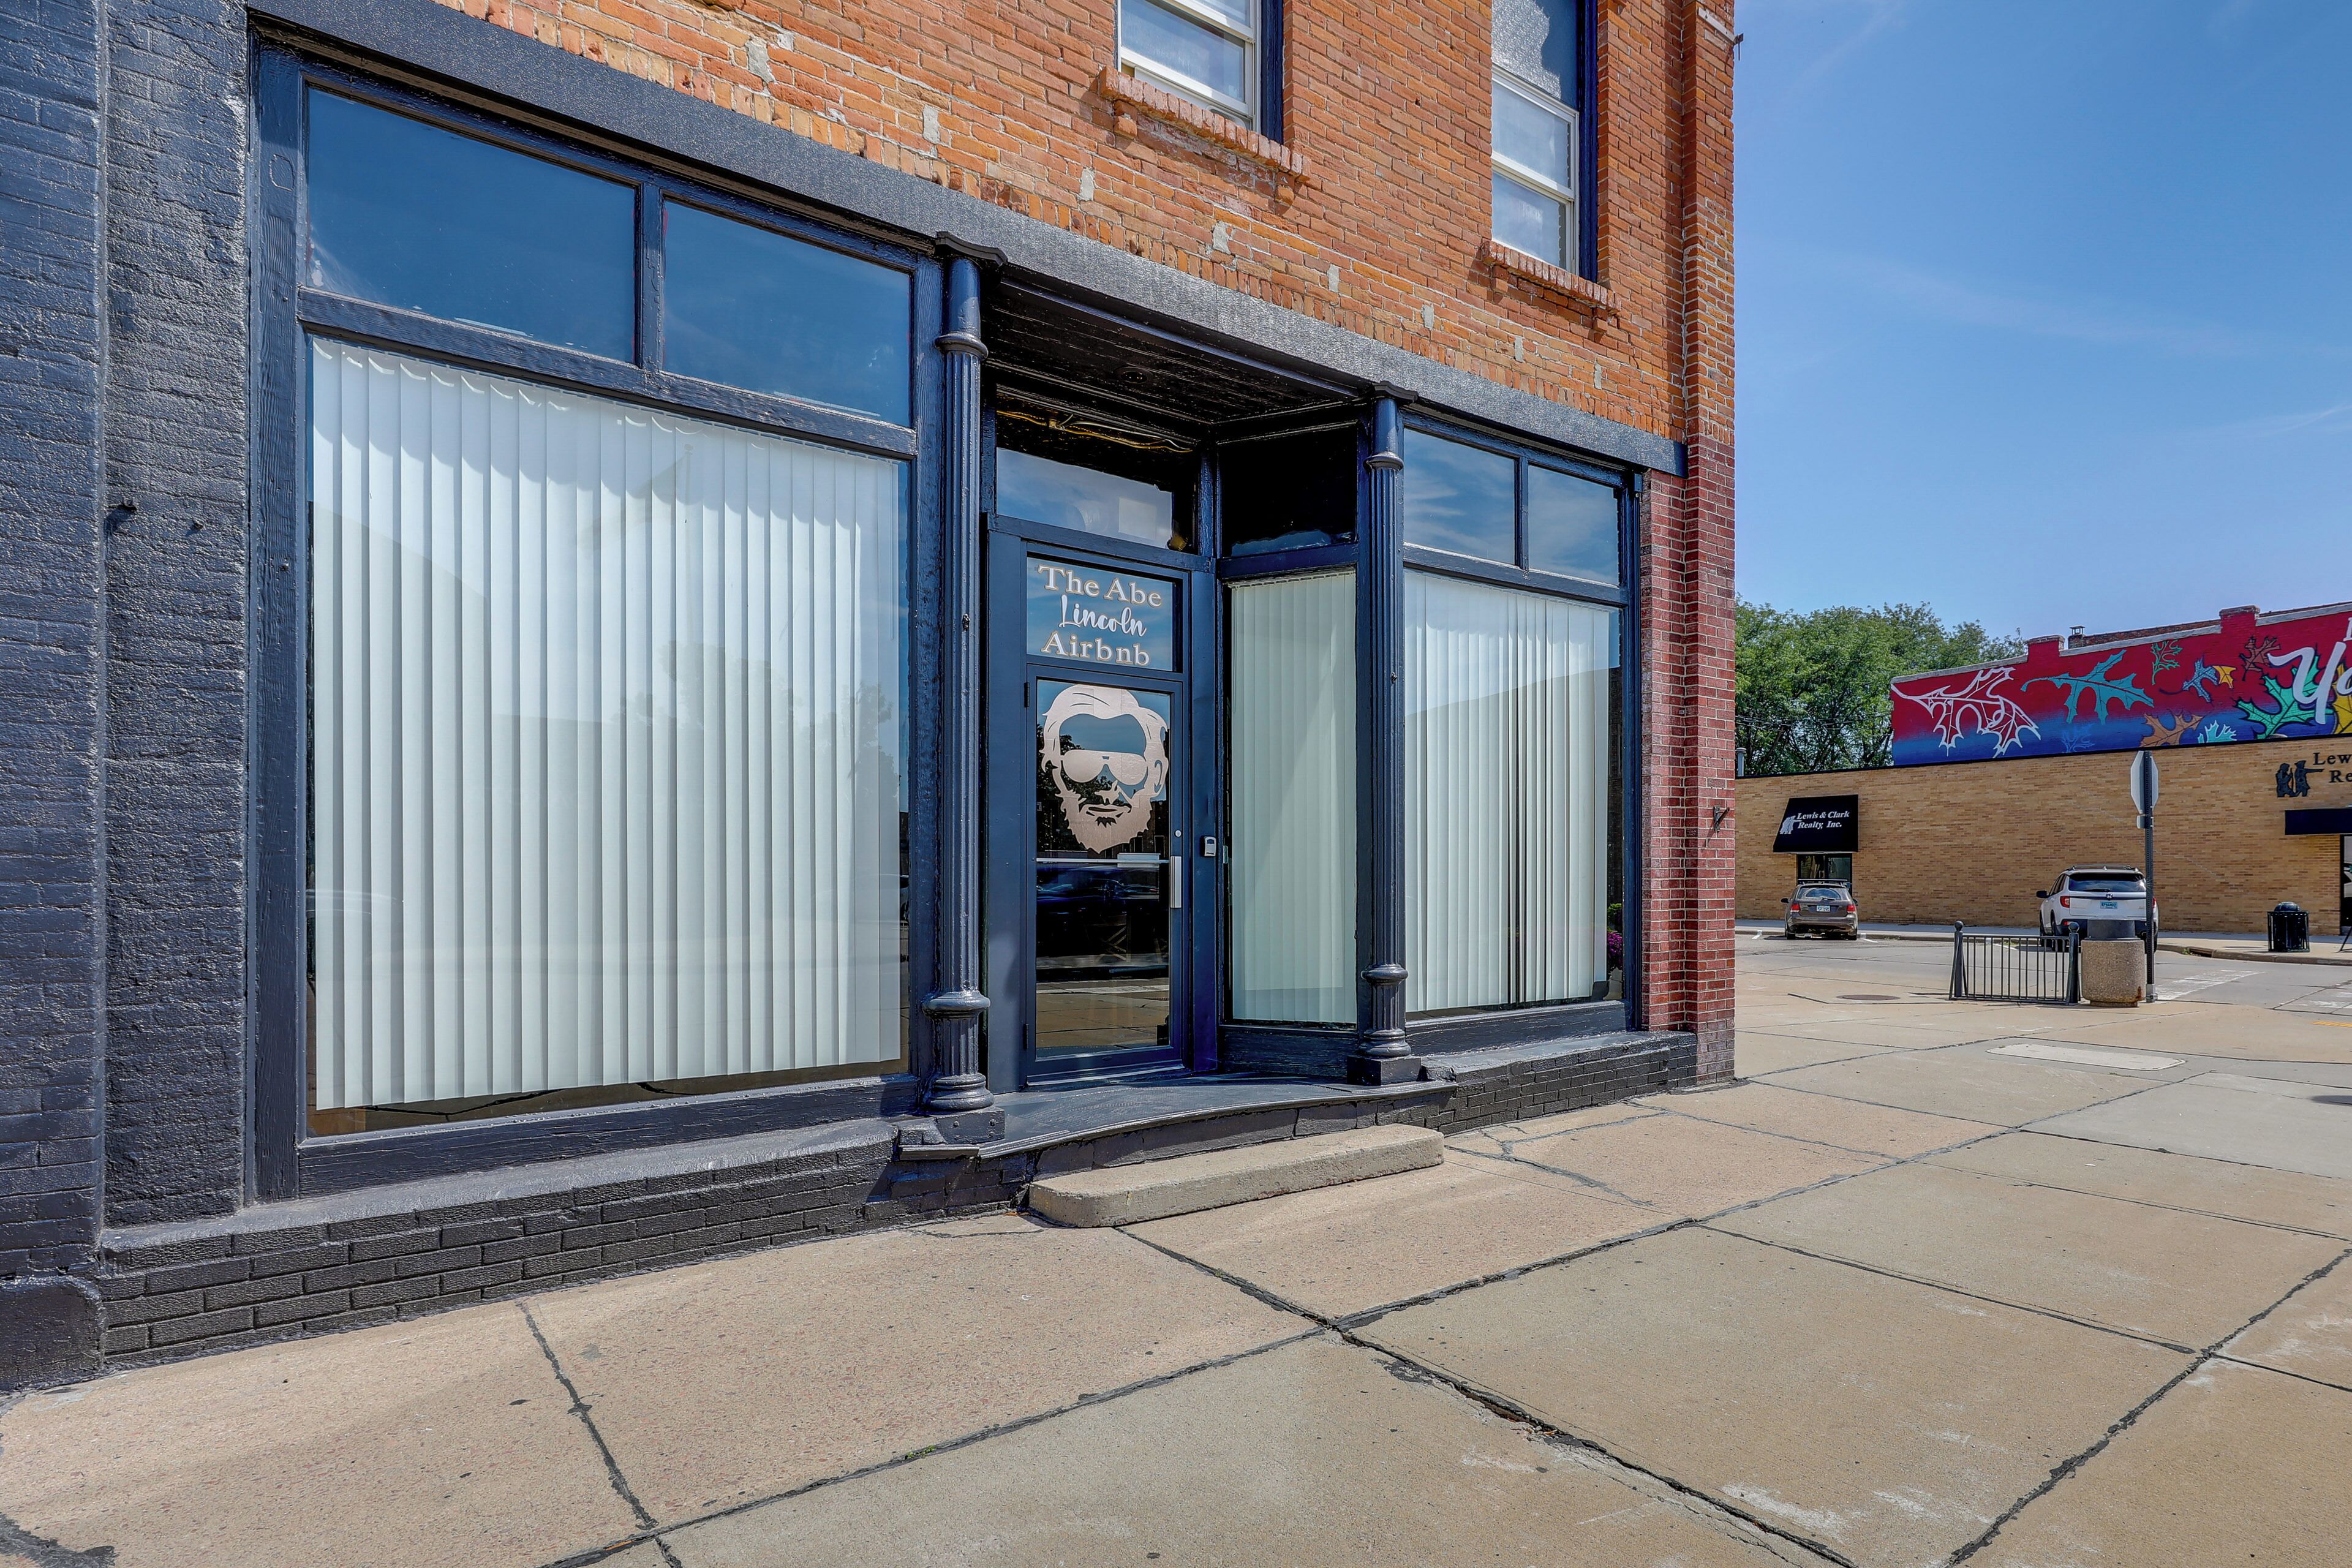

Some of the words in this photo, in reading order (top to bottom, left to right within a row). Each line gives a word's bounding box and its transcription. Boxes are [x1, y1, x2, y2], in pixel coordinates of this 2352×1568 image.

[1038, 564, 1100, 597] The
[1104, 578, 1162, 608] Abe
[1058, 594, 1147, 637] Lincoln
[1040, 631, 1150, 666] Airbnb
